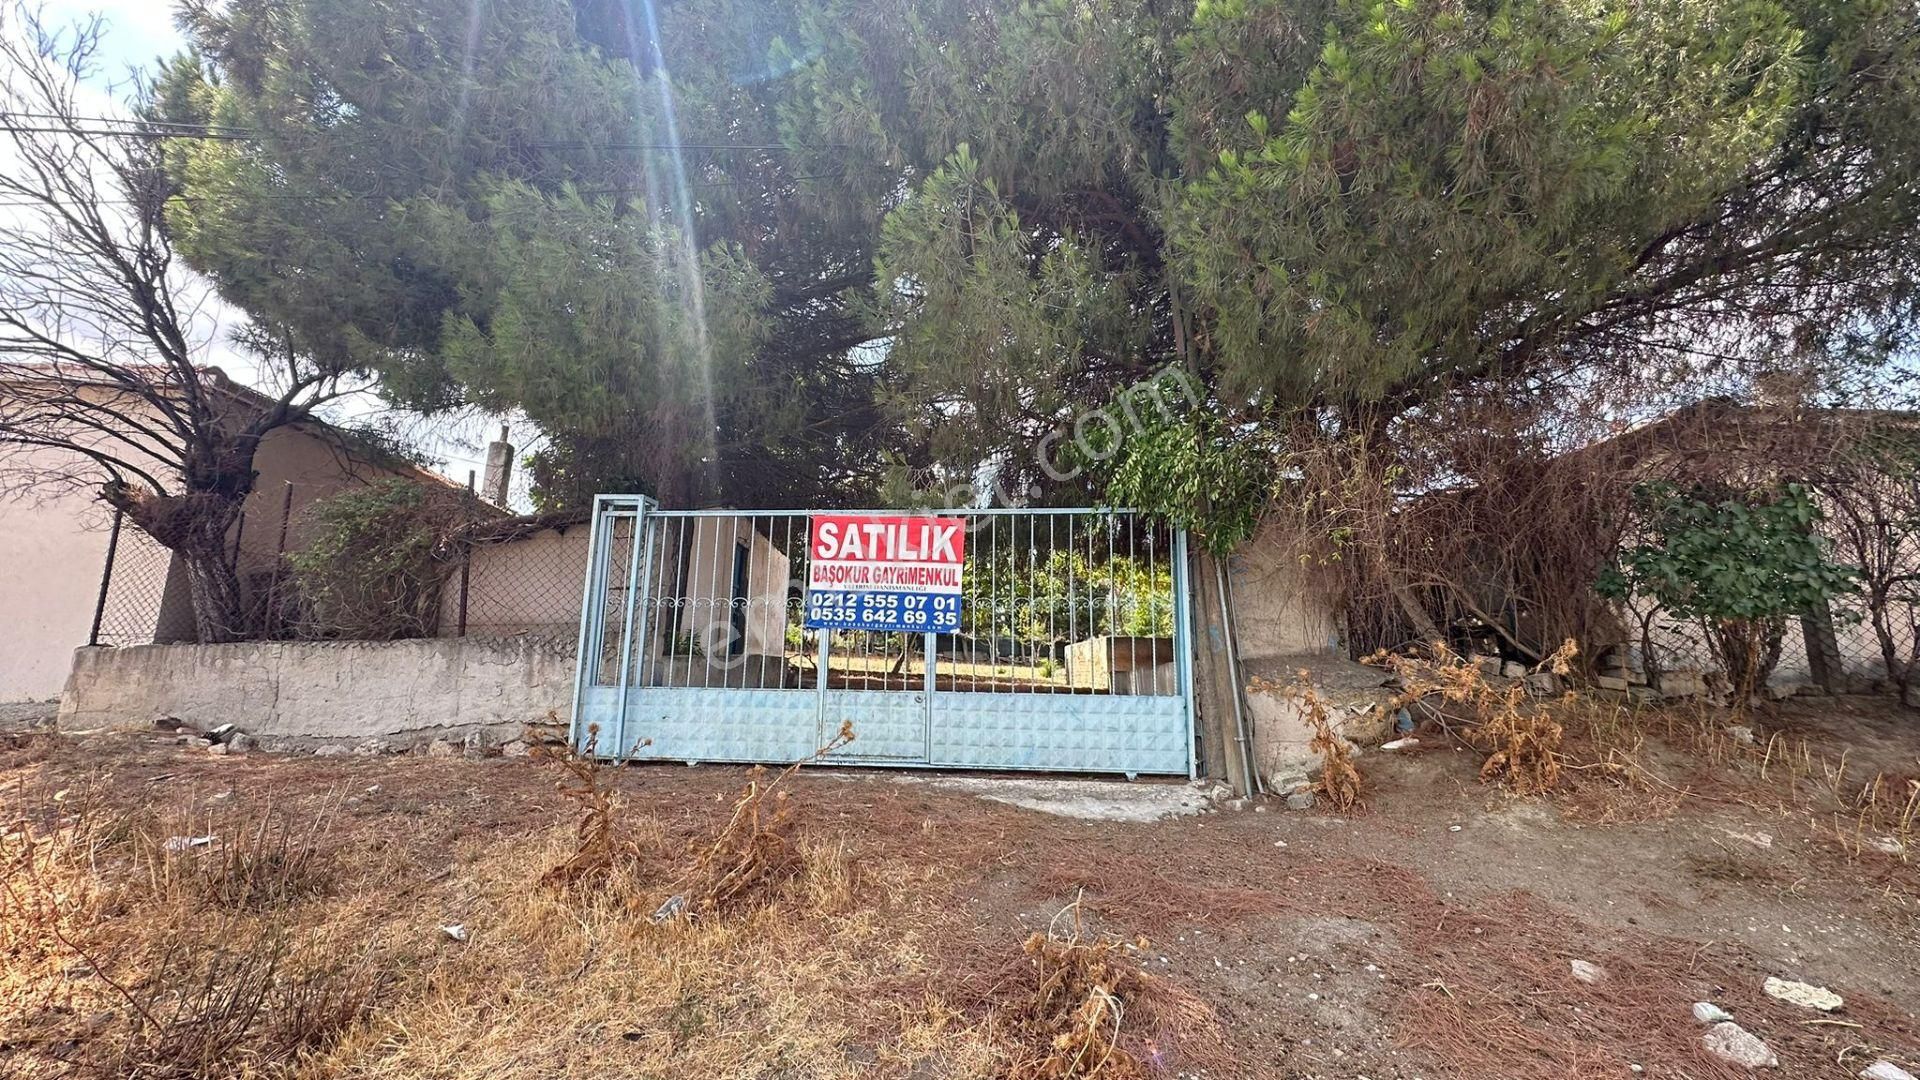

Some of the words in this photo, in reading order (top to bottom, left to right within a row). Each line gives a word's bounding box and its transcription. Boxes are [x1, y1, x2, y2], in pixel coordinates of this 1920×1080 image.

[817, 522, 959, 562] SATILIK
[813, 565, 870, 587] BAŞOKUR
[812, 593, 857, 607] 0212
[863, 594, 898, 608] 555
[904, 596, 928, 609] 07
[933, 597, 956, 610] 01
[810, 607, 857, 621] 0535
[862, 609, 898, 623] 642
[903, 610, 927, 625] 69
[933, 611, 957, 625] 35
